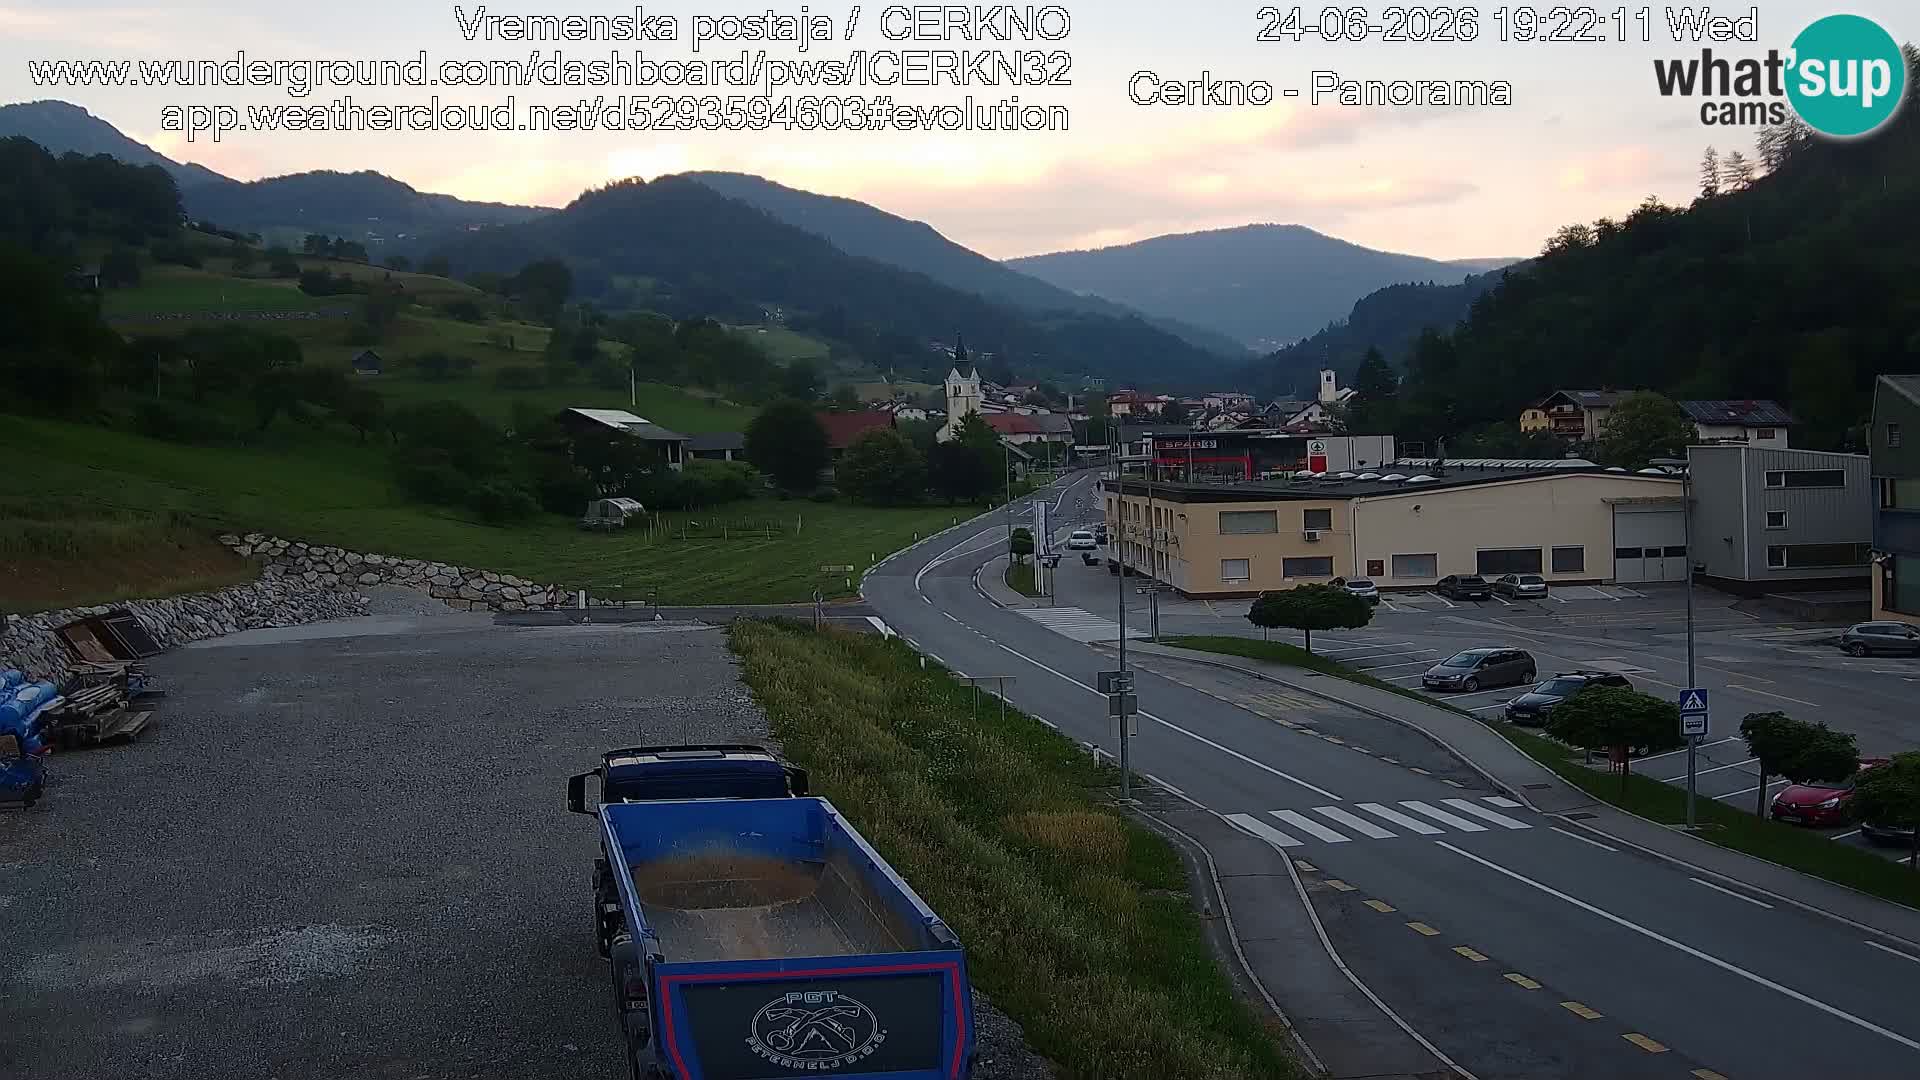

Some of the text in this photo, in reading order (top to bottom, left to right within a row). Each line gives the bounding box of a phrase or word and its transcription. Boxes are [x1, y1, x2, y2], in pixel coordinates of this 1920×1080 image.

[1165, 440, 1201, 449] SPAR
[785, 990, 838, 1005] PGT
[745, 1035, 841, 1070] PETERNELJ
